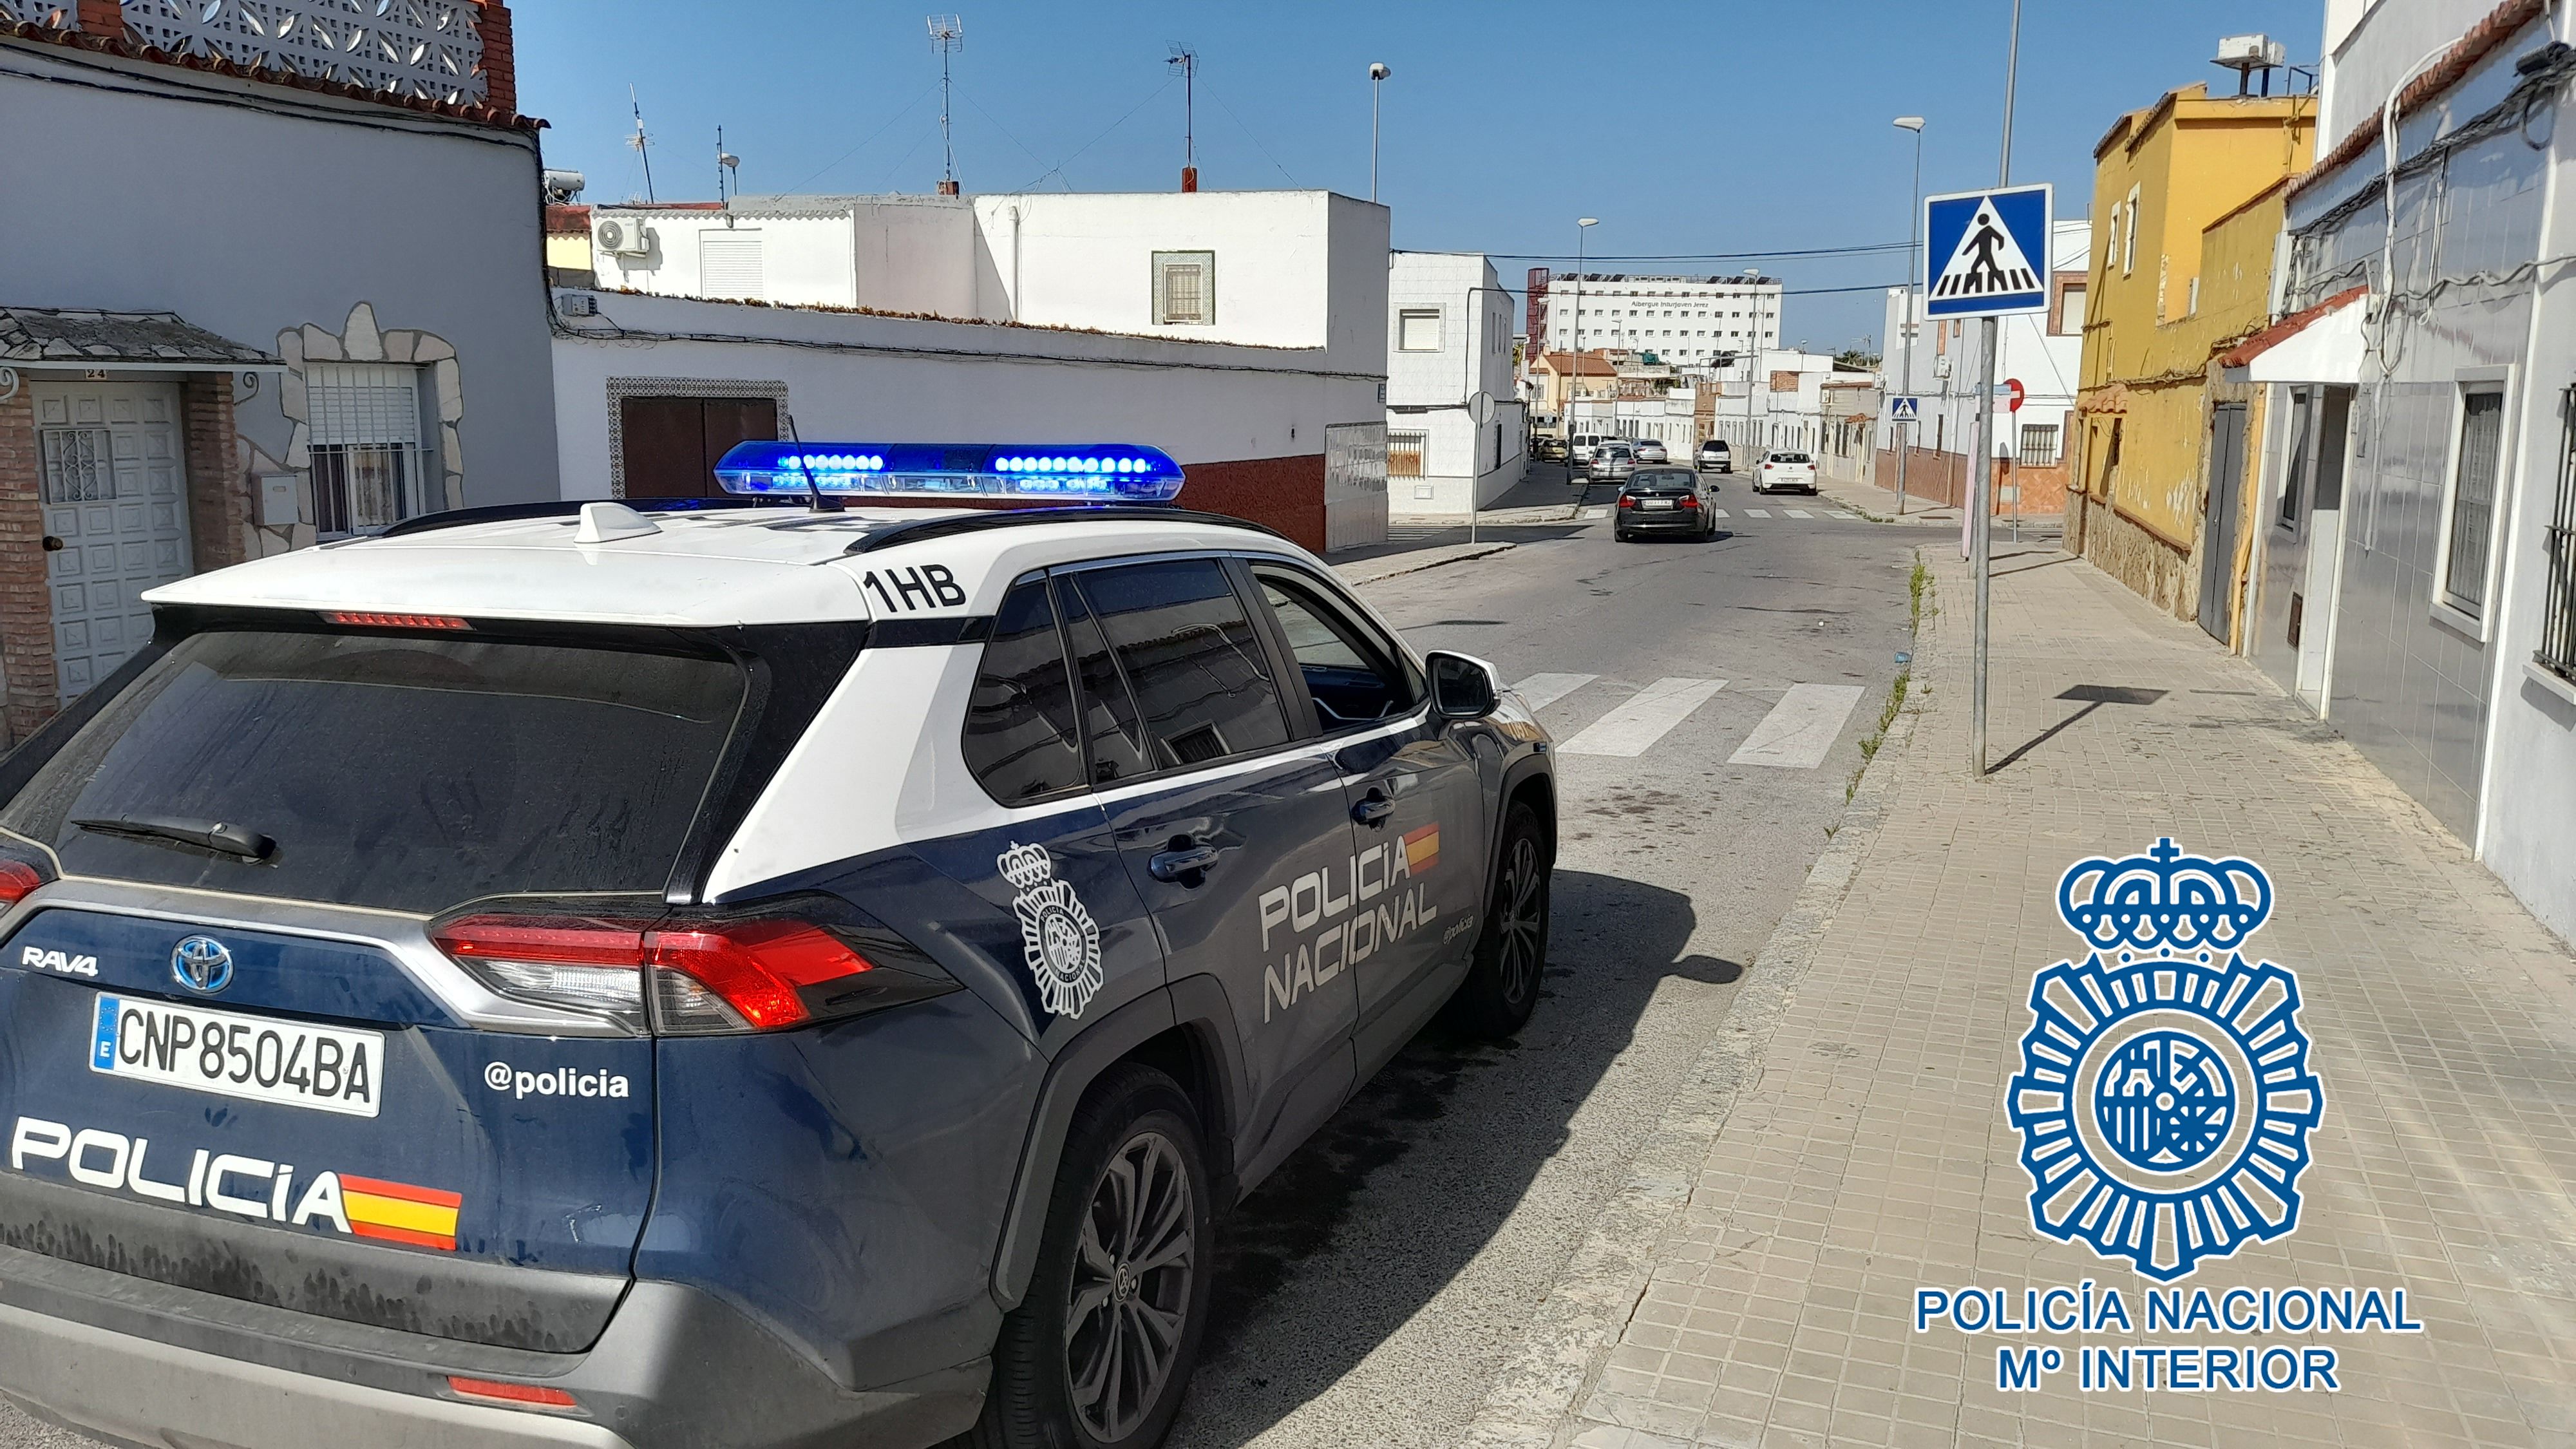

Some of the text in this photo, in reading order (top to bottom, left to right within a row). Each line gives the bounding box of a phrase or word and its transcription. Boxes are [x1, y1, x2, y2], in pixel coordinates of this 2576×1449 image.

[87, 369, 105, 377] 24
[863, 564, 966, 612] 1HB
[22, 946, 99, 976] RAV4
[1264, 882, 1437, 1023] NACIONAL
[100, 1041, 111, 1058] E
[484, 1061, 629, 1099] @policia
